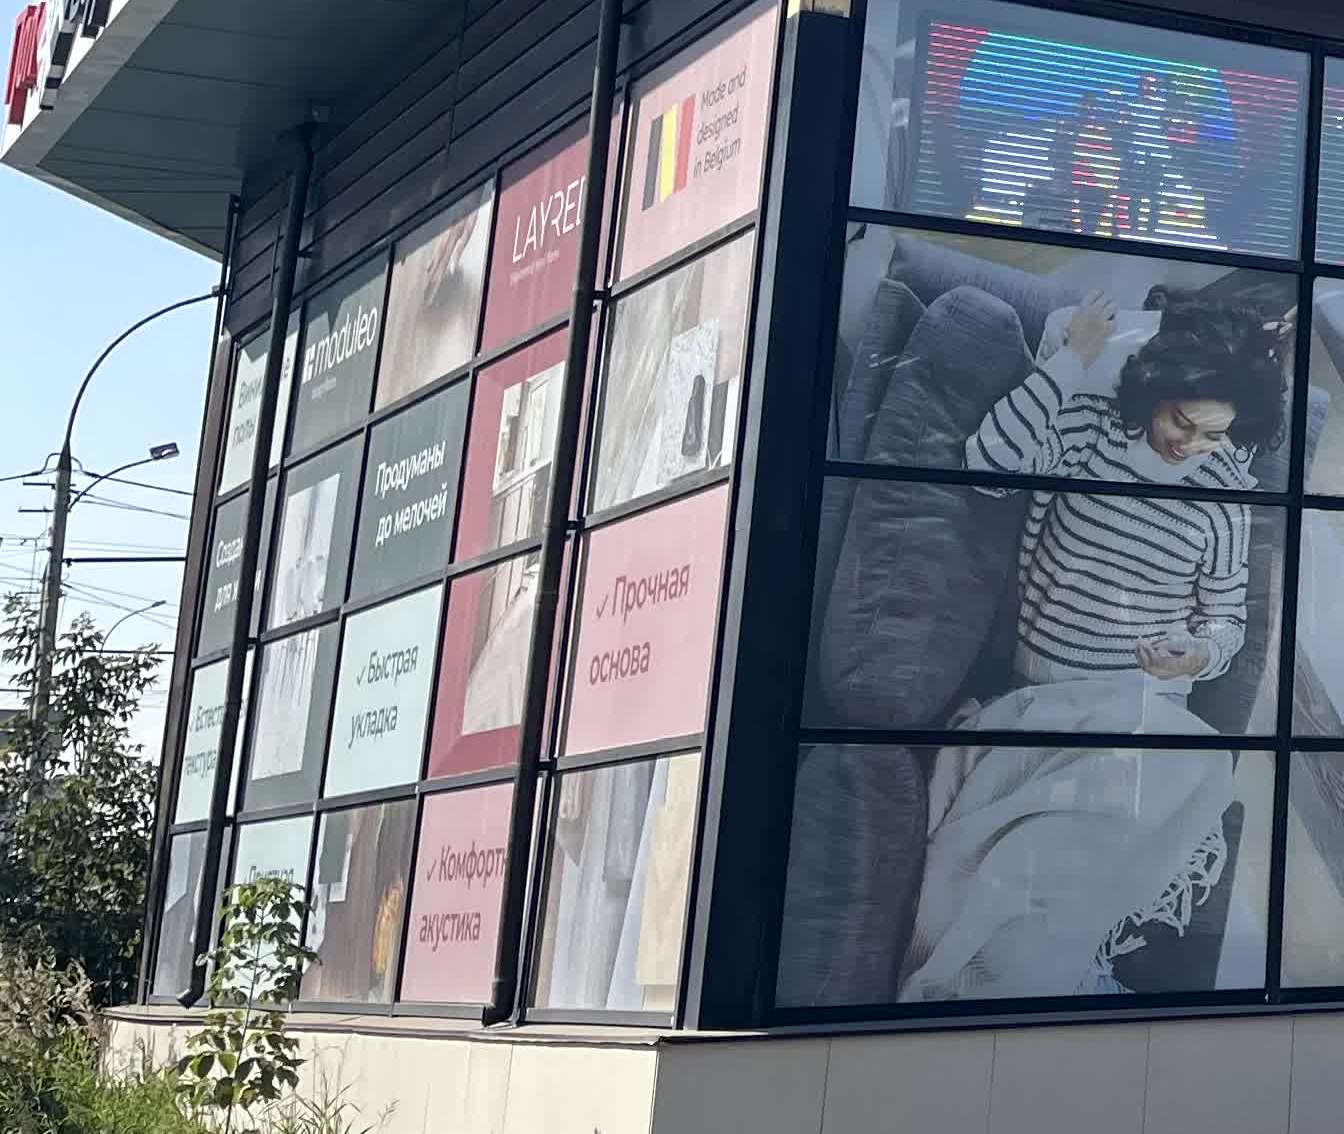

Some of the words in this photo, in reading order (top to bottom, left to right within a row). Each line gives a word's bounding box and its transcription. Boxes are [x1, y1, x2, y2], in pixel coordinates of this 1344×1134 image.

[696, 101, 740, 145] designed
[703, 136, 742, 173] Belgium
[313, 305, 378, 378] moduleo
[375, 440, 446, 498] Продуманы
[375, 514, 393, 547] до
[394, 481, 449, 535] мелочей
[612, 564, 691, 625] Прочная
[367, 644, 419, 686] Быстрая
[589, 641, 651, 687] основа
[348, 703, 399, 750] укладка
[419, 909, 482, 952] акустика
